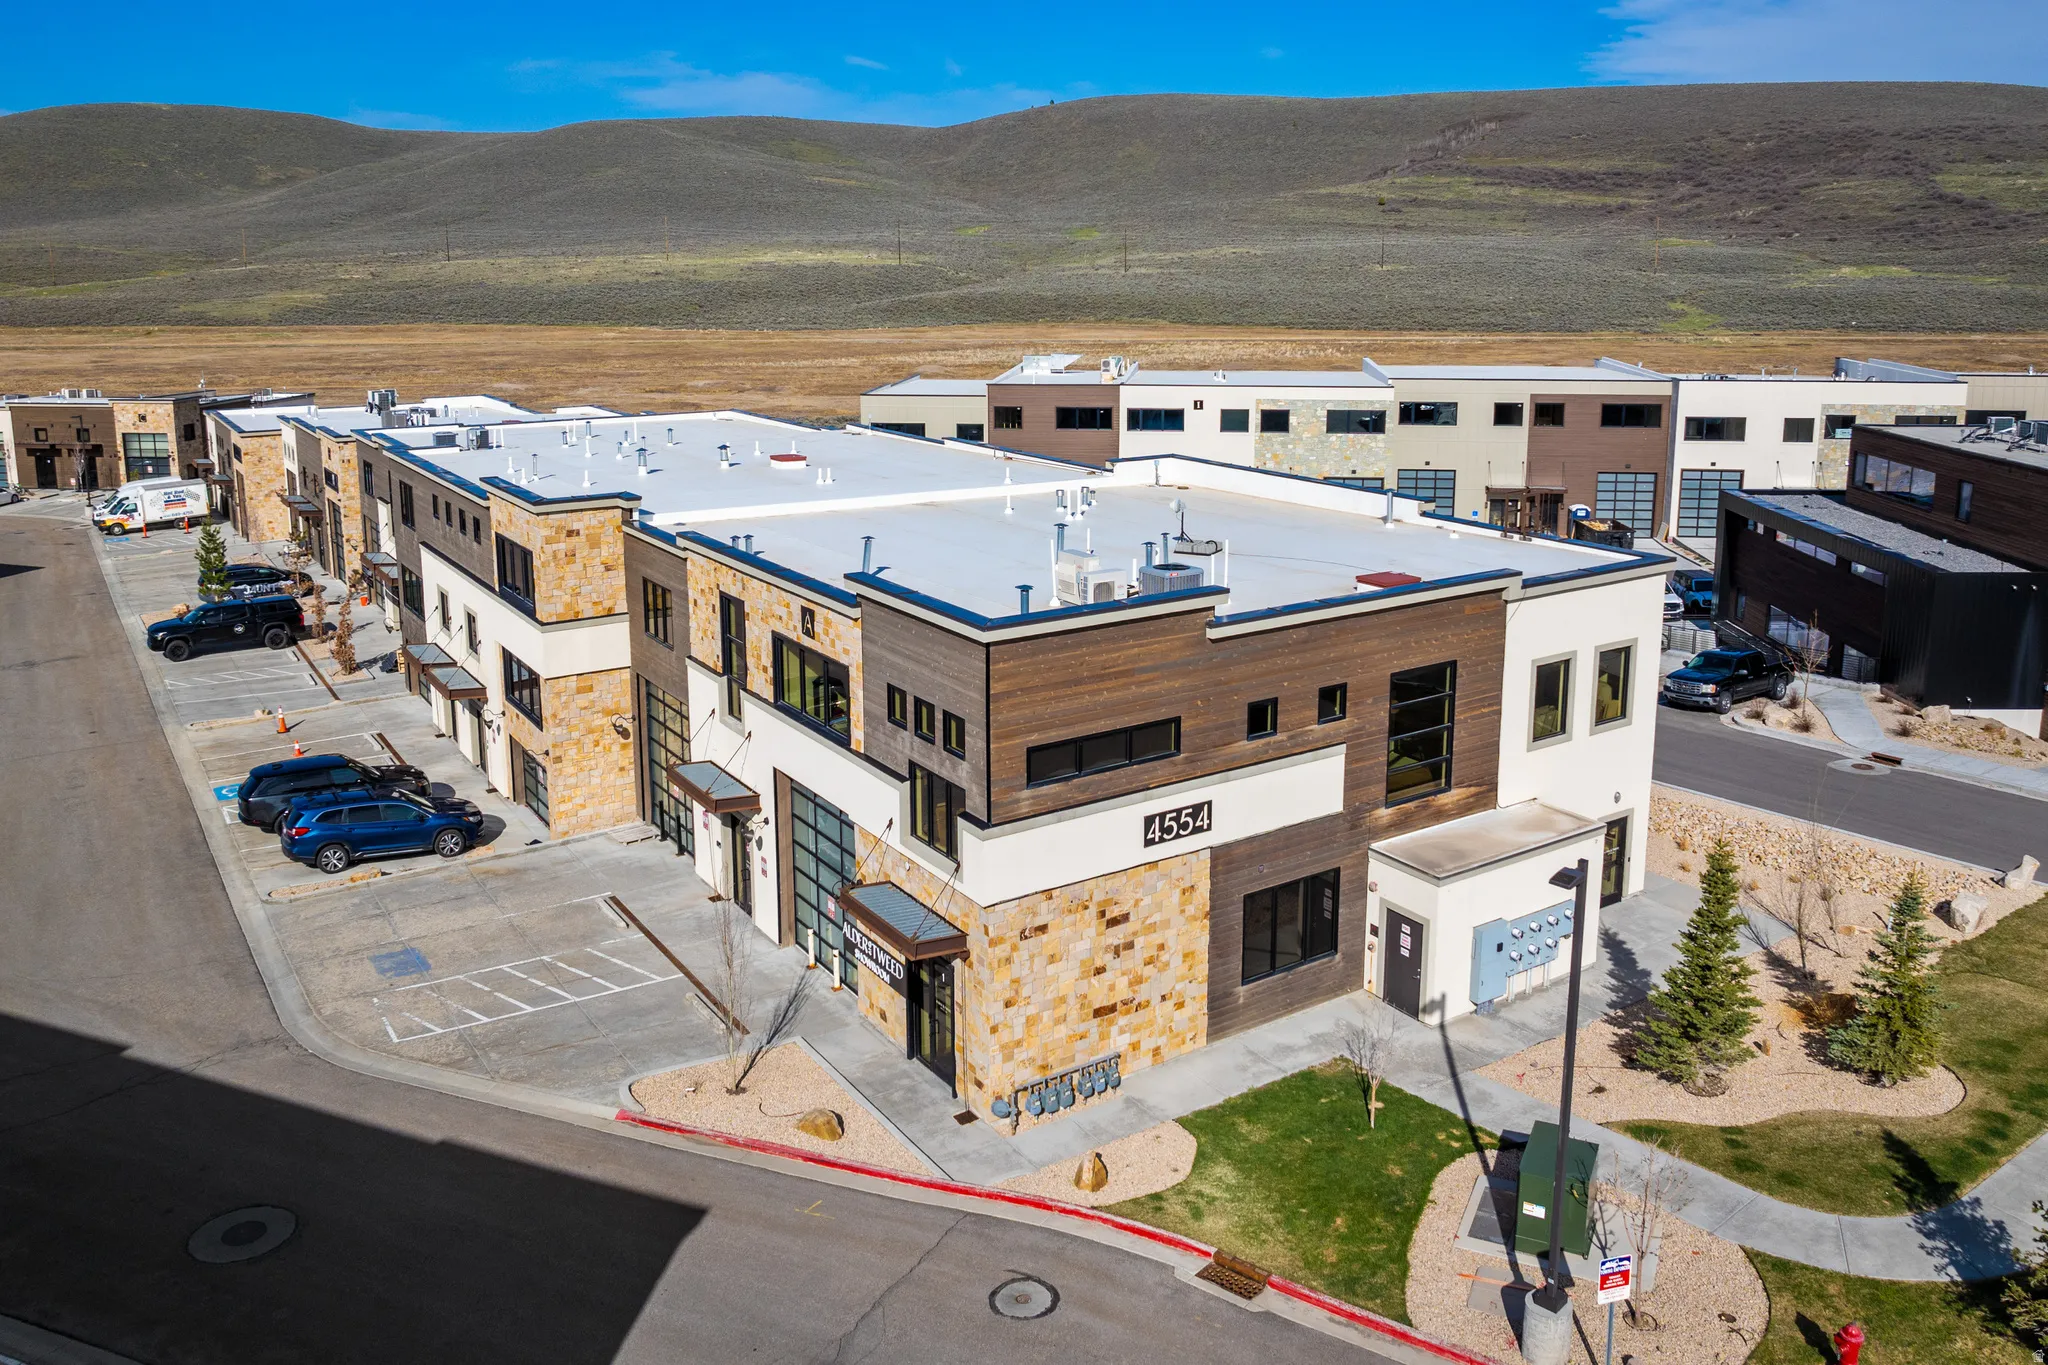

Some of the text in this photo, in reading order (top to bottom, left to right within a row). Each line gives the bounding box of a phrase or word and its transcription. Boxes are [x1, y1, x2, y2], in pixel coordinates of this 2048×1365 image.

[243, 583, 277, 595] JAUNT
[803, 611, 814, 637] A
[1146, 803, 1210, 843] 4554
[842, 921, 869, 954] ALDER
[871, 943, 904, 980] TWEED
[854, 948, 890, 984] SHOWROOM
[941, 972, 945, 983] 1
